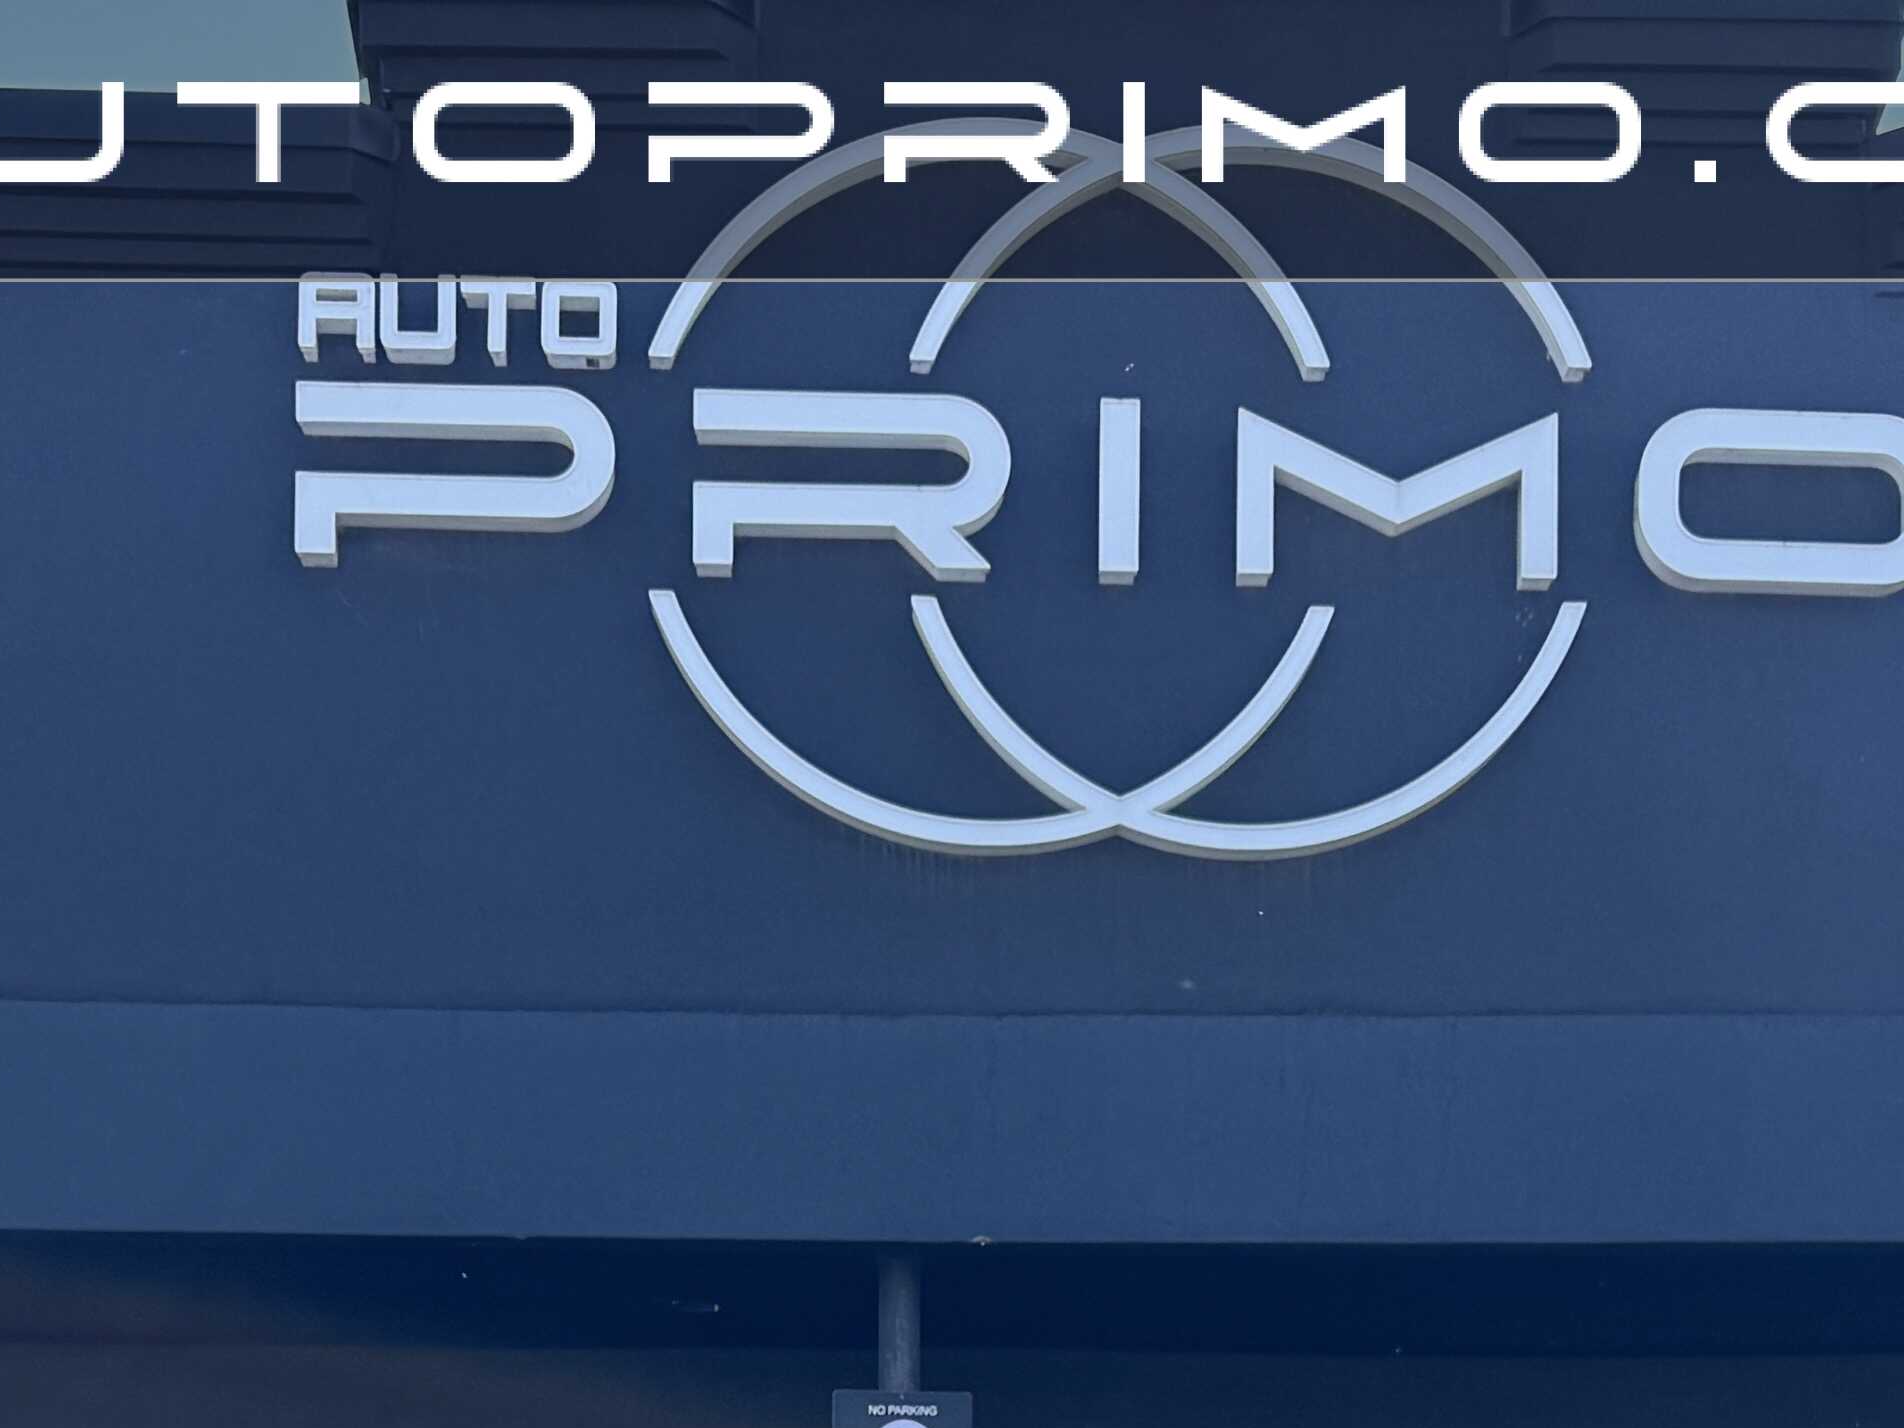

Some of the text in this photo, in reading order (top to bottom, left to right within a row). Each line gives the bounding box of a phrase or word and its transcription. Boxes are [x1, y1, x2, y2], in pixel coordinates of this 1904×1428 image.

[297, 272, 618, 370] AUTO
[868, 1405, 938, 1416] NO PARKING
